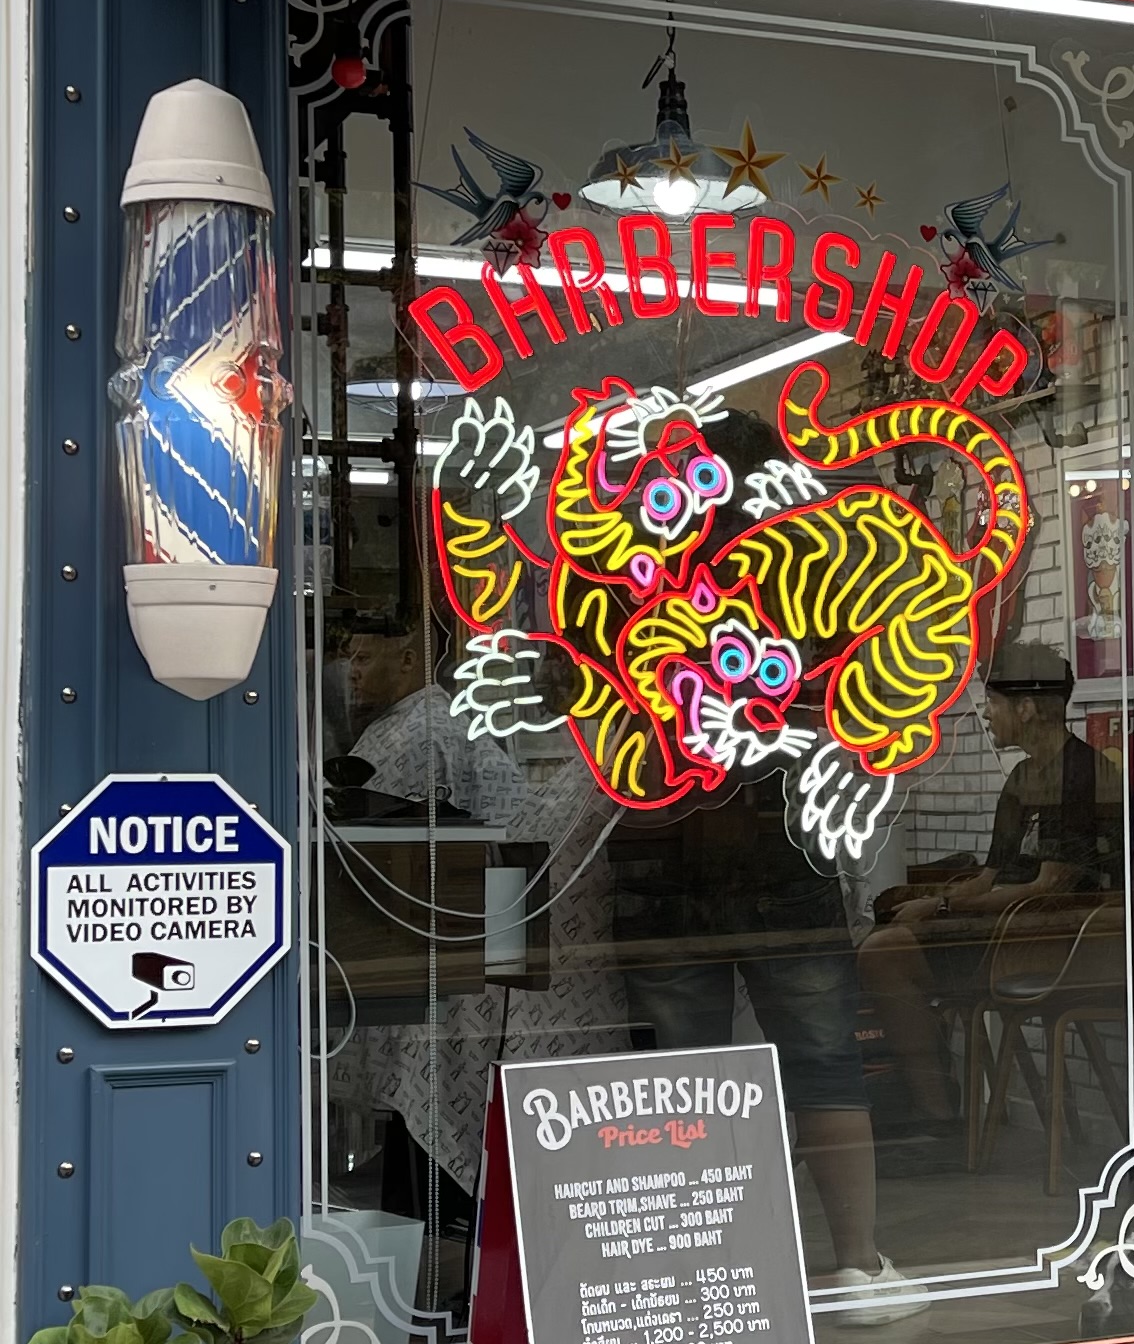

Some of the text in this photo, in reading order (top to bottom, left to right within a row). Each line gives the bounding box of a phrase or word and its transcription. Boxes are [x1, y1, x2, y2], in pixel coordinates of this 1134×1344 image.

[409, 215, 1028, 404] BARBERSHOP
[89, 816, 239, 854] NOTICE
[66, 871, 257, 893] ALL ACTIVITIES
[67, 895, 257, 918] MONITORED BY
[66, 919, 256, 942] VIDEO CAMERA
[523, 1077, 763, 1151] BARBERSHOP
[598, 1119, 707, 1149] Price List
[554, 1180, 603, 1200] HAIRCUT
[606, 1177, 630, 1194] AND
[631, 1172, 686, 1192] SHAMPOO
[701, 1168, 722, 1184] 450
[724, 1165, 753, 1181] BAHT
[569, 1201, 607, 1220] BEARD
[692, 1190, 713, 1206] 250
[716, 1186, 744, 1202] BAHT
[585, 1217, 641, 1238] CHILDREN
[644, 1215, 665, 1231] CUT
[680, 1211, 702, 1228] 300
[705, 1208, 733, 1224] BAHT
[601, 1240, 632, 1259] HAIR
[631, 1238, 654, 1255] DYE
[668, 1234, 691, 1250] 900
[694, 1230, 722, 1246] BAHT
[579, 1282, 610, 1299] ตัดผม
[614, 1281, 636, 1295] และ
[641, 1275, 675, 1291] สระผม
[696, 1266, 727, 1283] 450
[730, 1266, 754, 1280] บาท
[581, 1299, 616, 1317] ตัดเด็ก
[700, 1284, 730, 1301] 300
[733, 1284, 756, 1298] บาท
[703, 1302, 733, 1320] 250
[737, 1301, 760, 1315] บาท
[699, 1319, 743, 1339] 2,500
[747, 1318, 770, 1332] บาท
